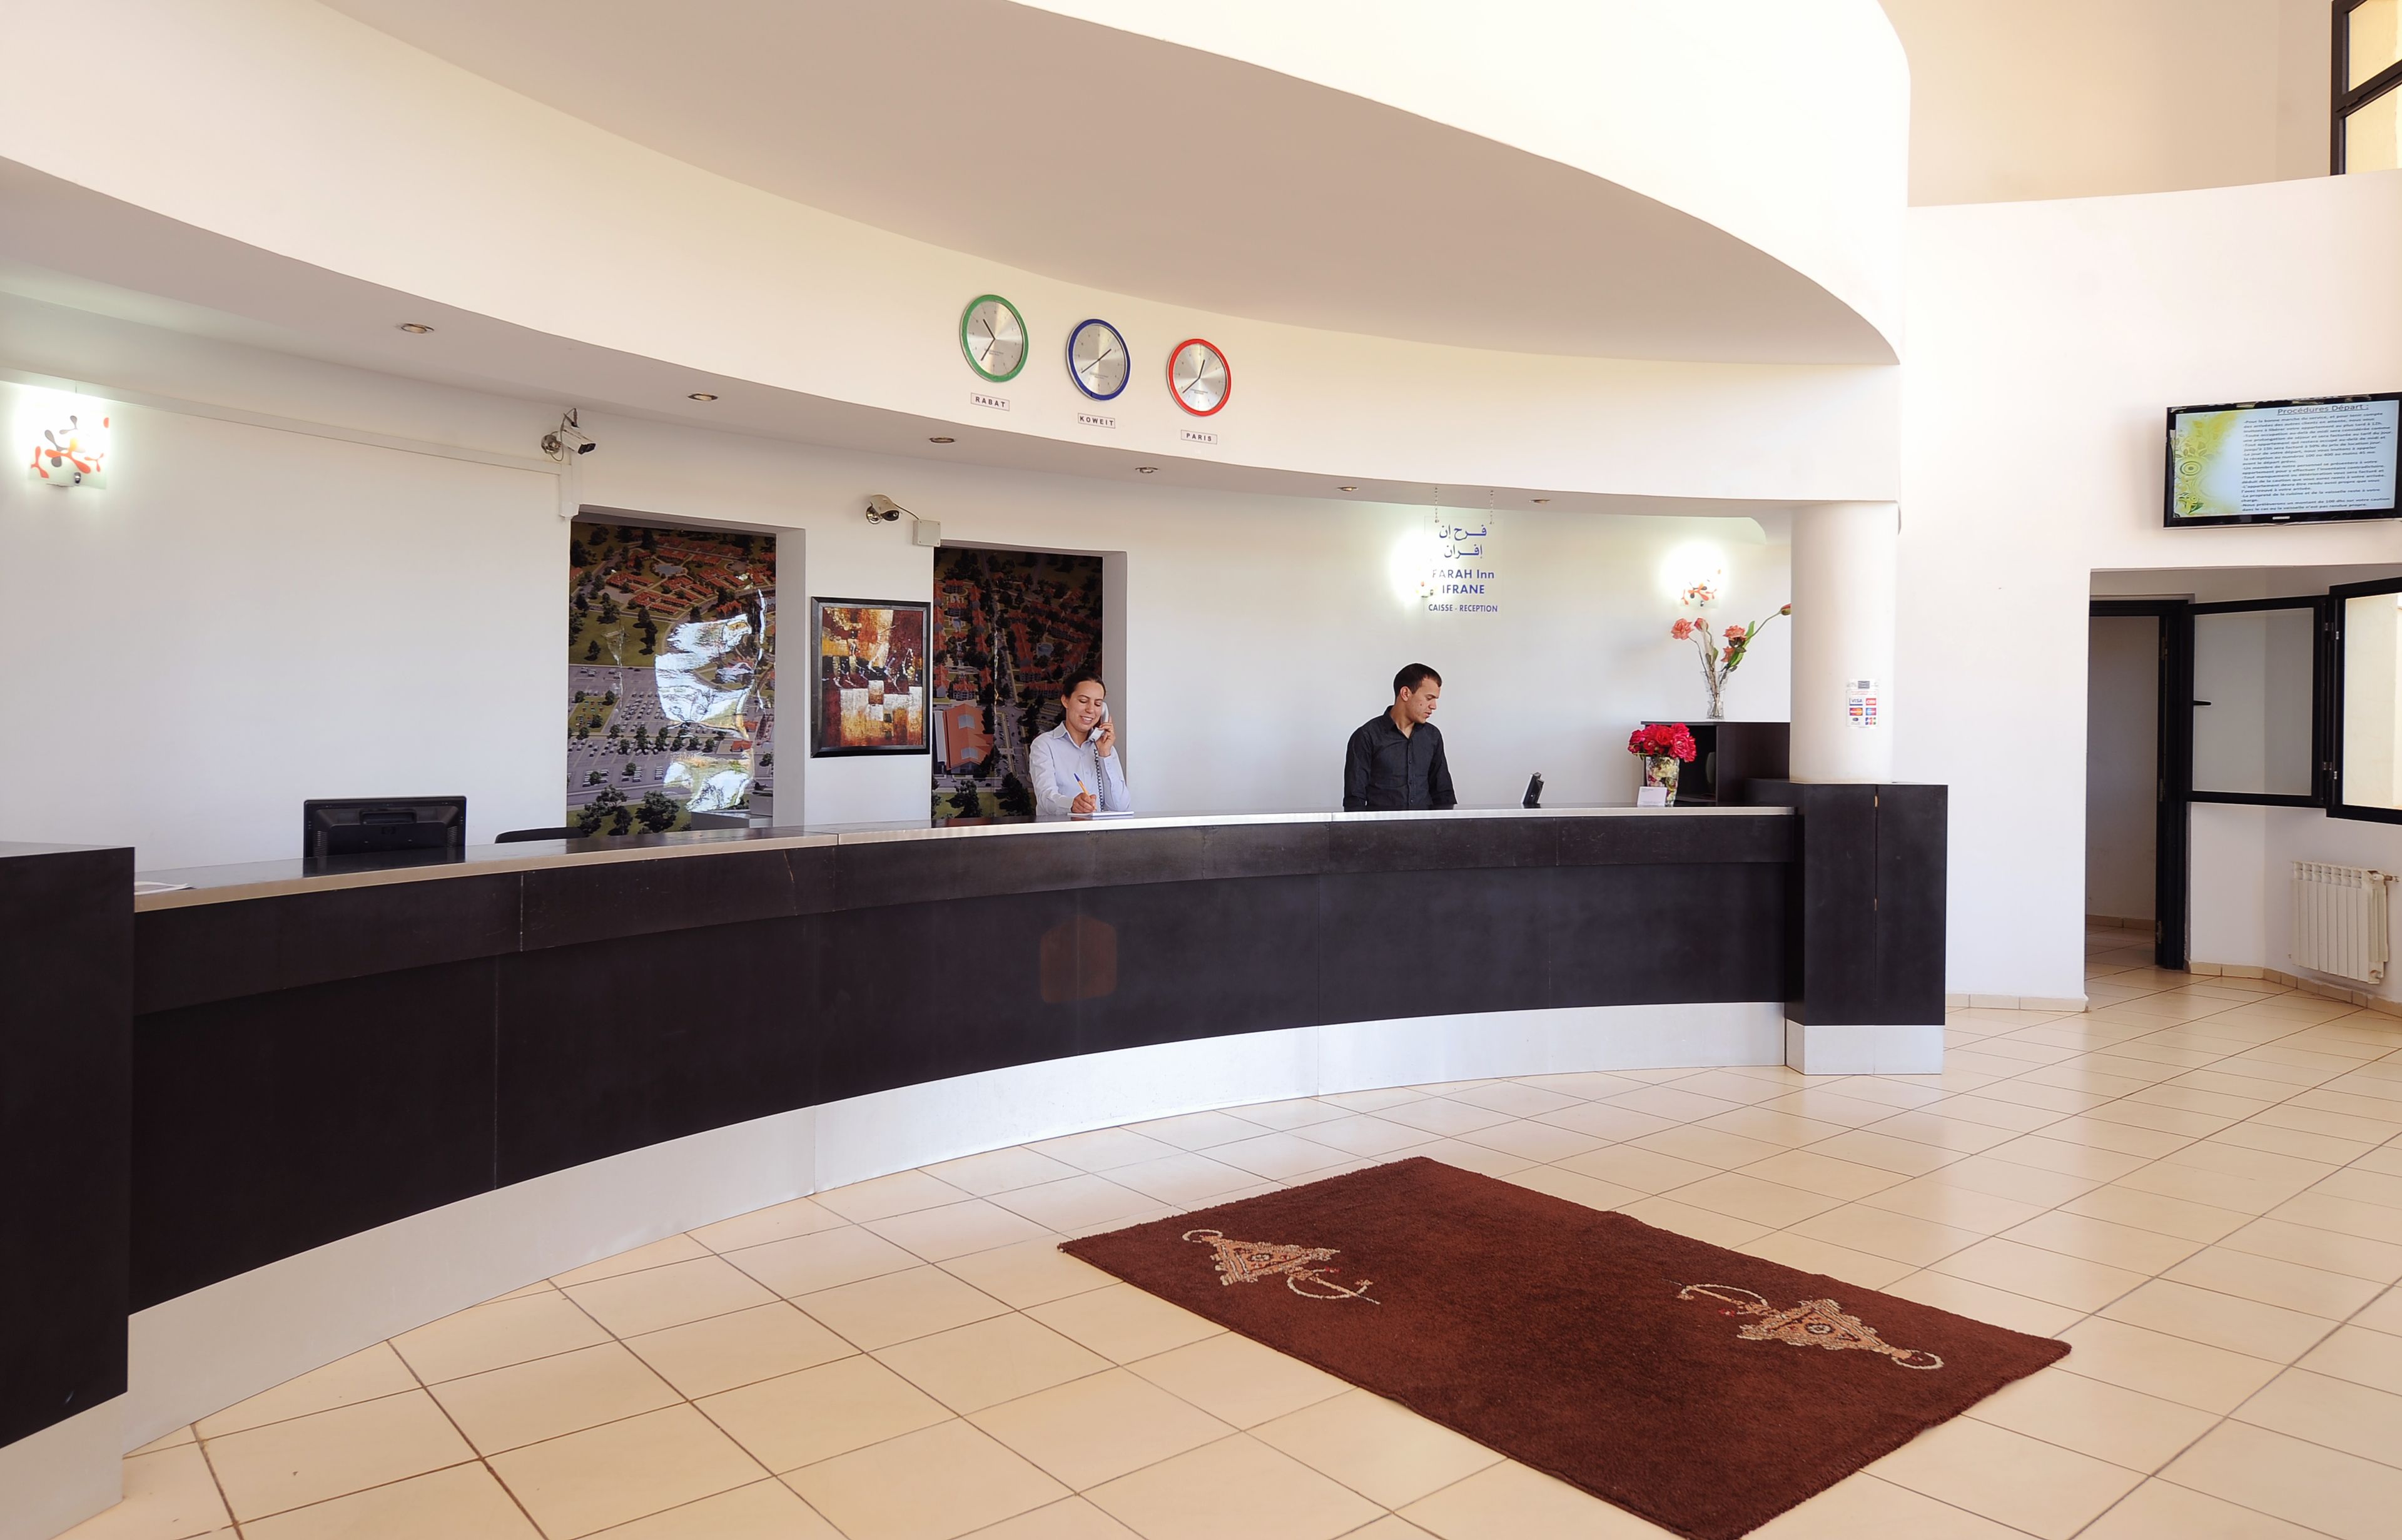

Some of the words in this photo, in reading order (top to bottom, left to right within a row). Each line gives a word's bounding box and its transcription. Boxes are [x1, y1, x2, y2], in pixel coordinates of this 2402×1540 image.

[975, 397, 1005, 408] RABAT
[1080, 415, 1114, 427] KOWEIT
[1186, 432, 1212, 442] PARIS
[1454, 524, 1487, 541] فرح
[1444, 544, 1483, 559] إفران
[1432, 569, 1472, 579] FARAH
[1476, 569, 1494, 579] Inn
[1442, 584, 1485, 594] IFRANE
[1428, 604, 1453, 612] CAISSE
[1459, 604, 1498, 612] RECEPTION
